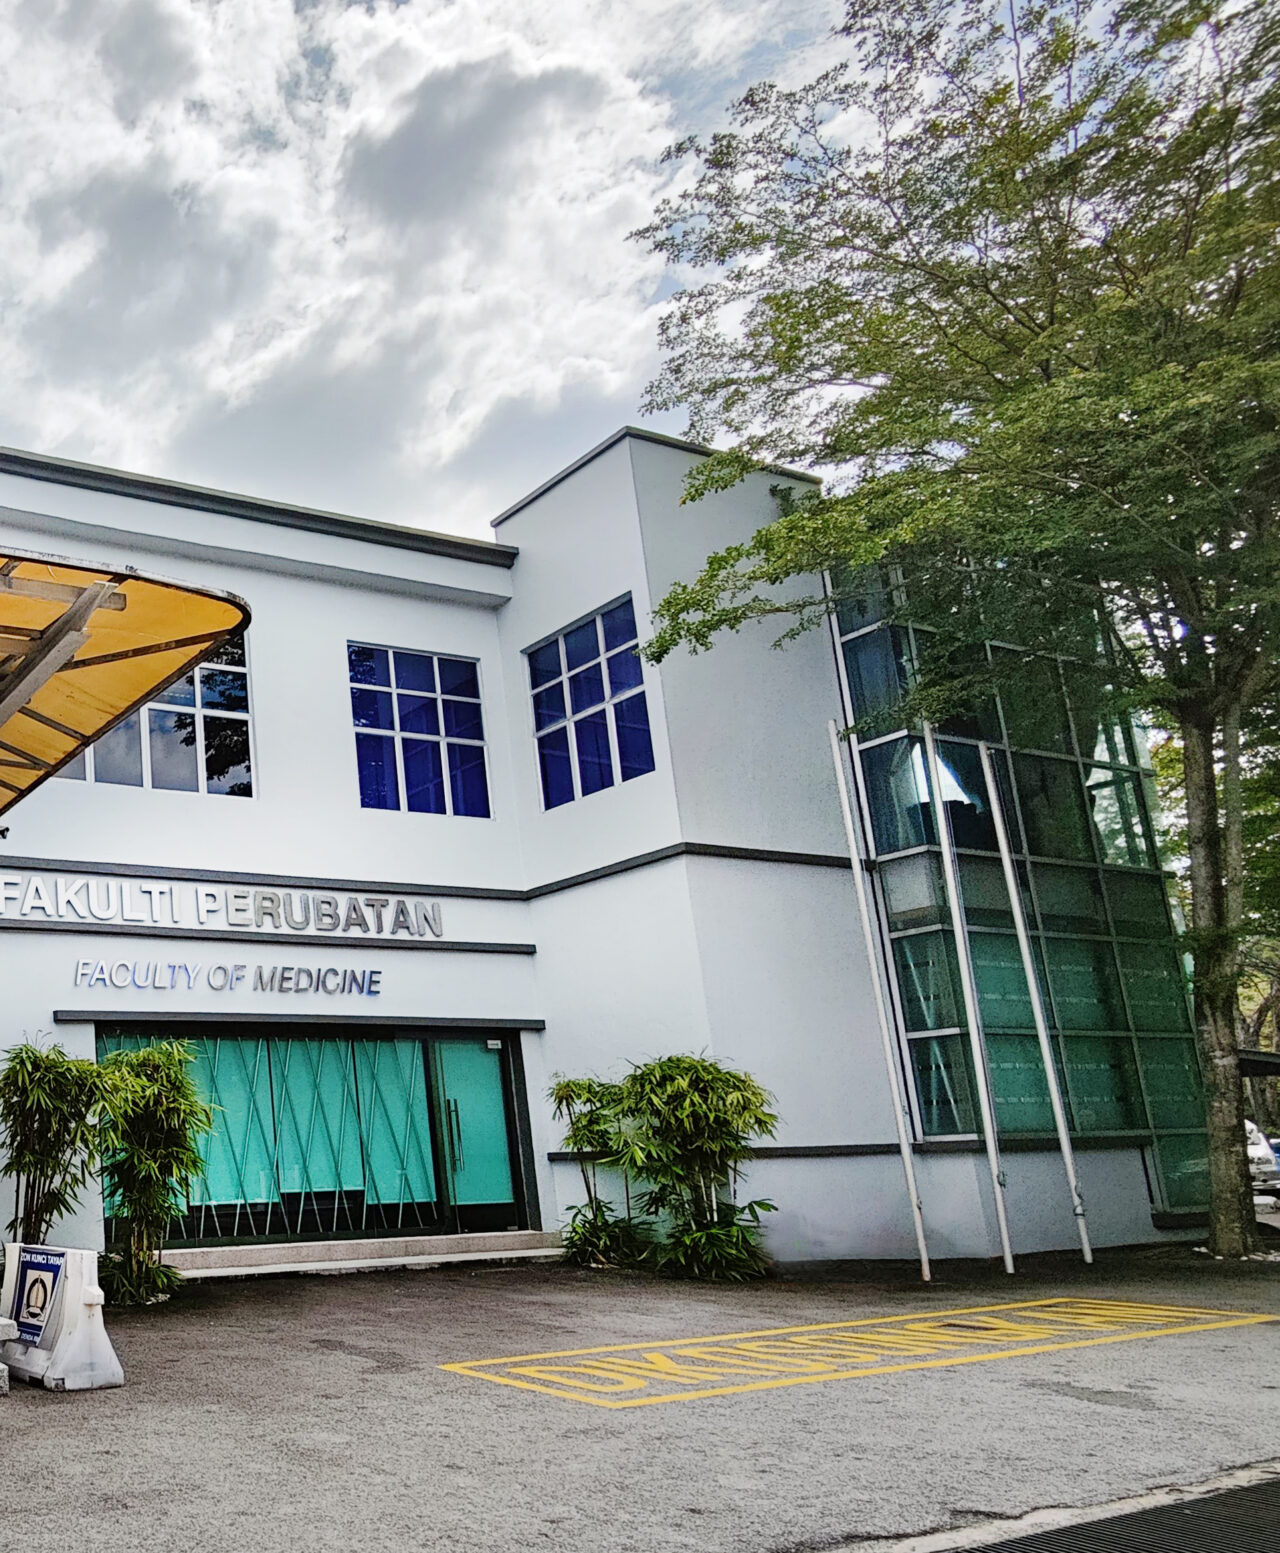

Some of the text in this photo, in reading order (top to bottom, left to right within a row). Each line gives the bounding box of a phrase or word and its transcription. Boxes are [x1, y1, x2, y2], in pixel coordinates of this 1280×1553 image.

[198, 887, 444, 937] PERUBATAN
[73, 958, 383, 996] FACULTY OF MEDICINE
[32, 1254, 47, 1263] KUNCI
[506, 1303, 1220, 1393] DIKOSONGKAN
